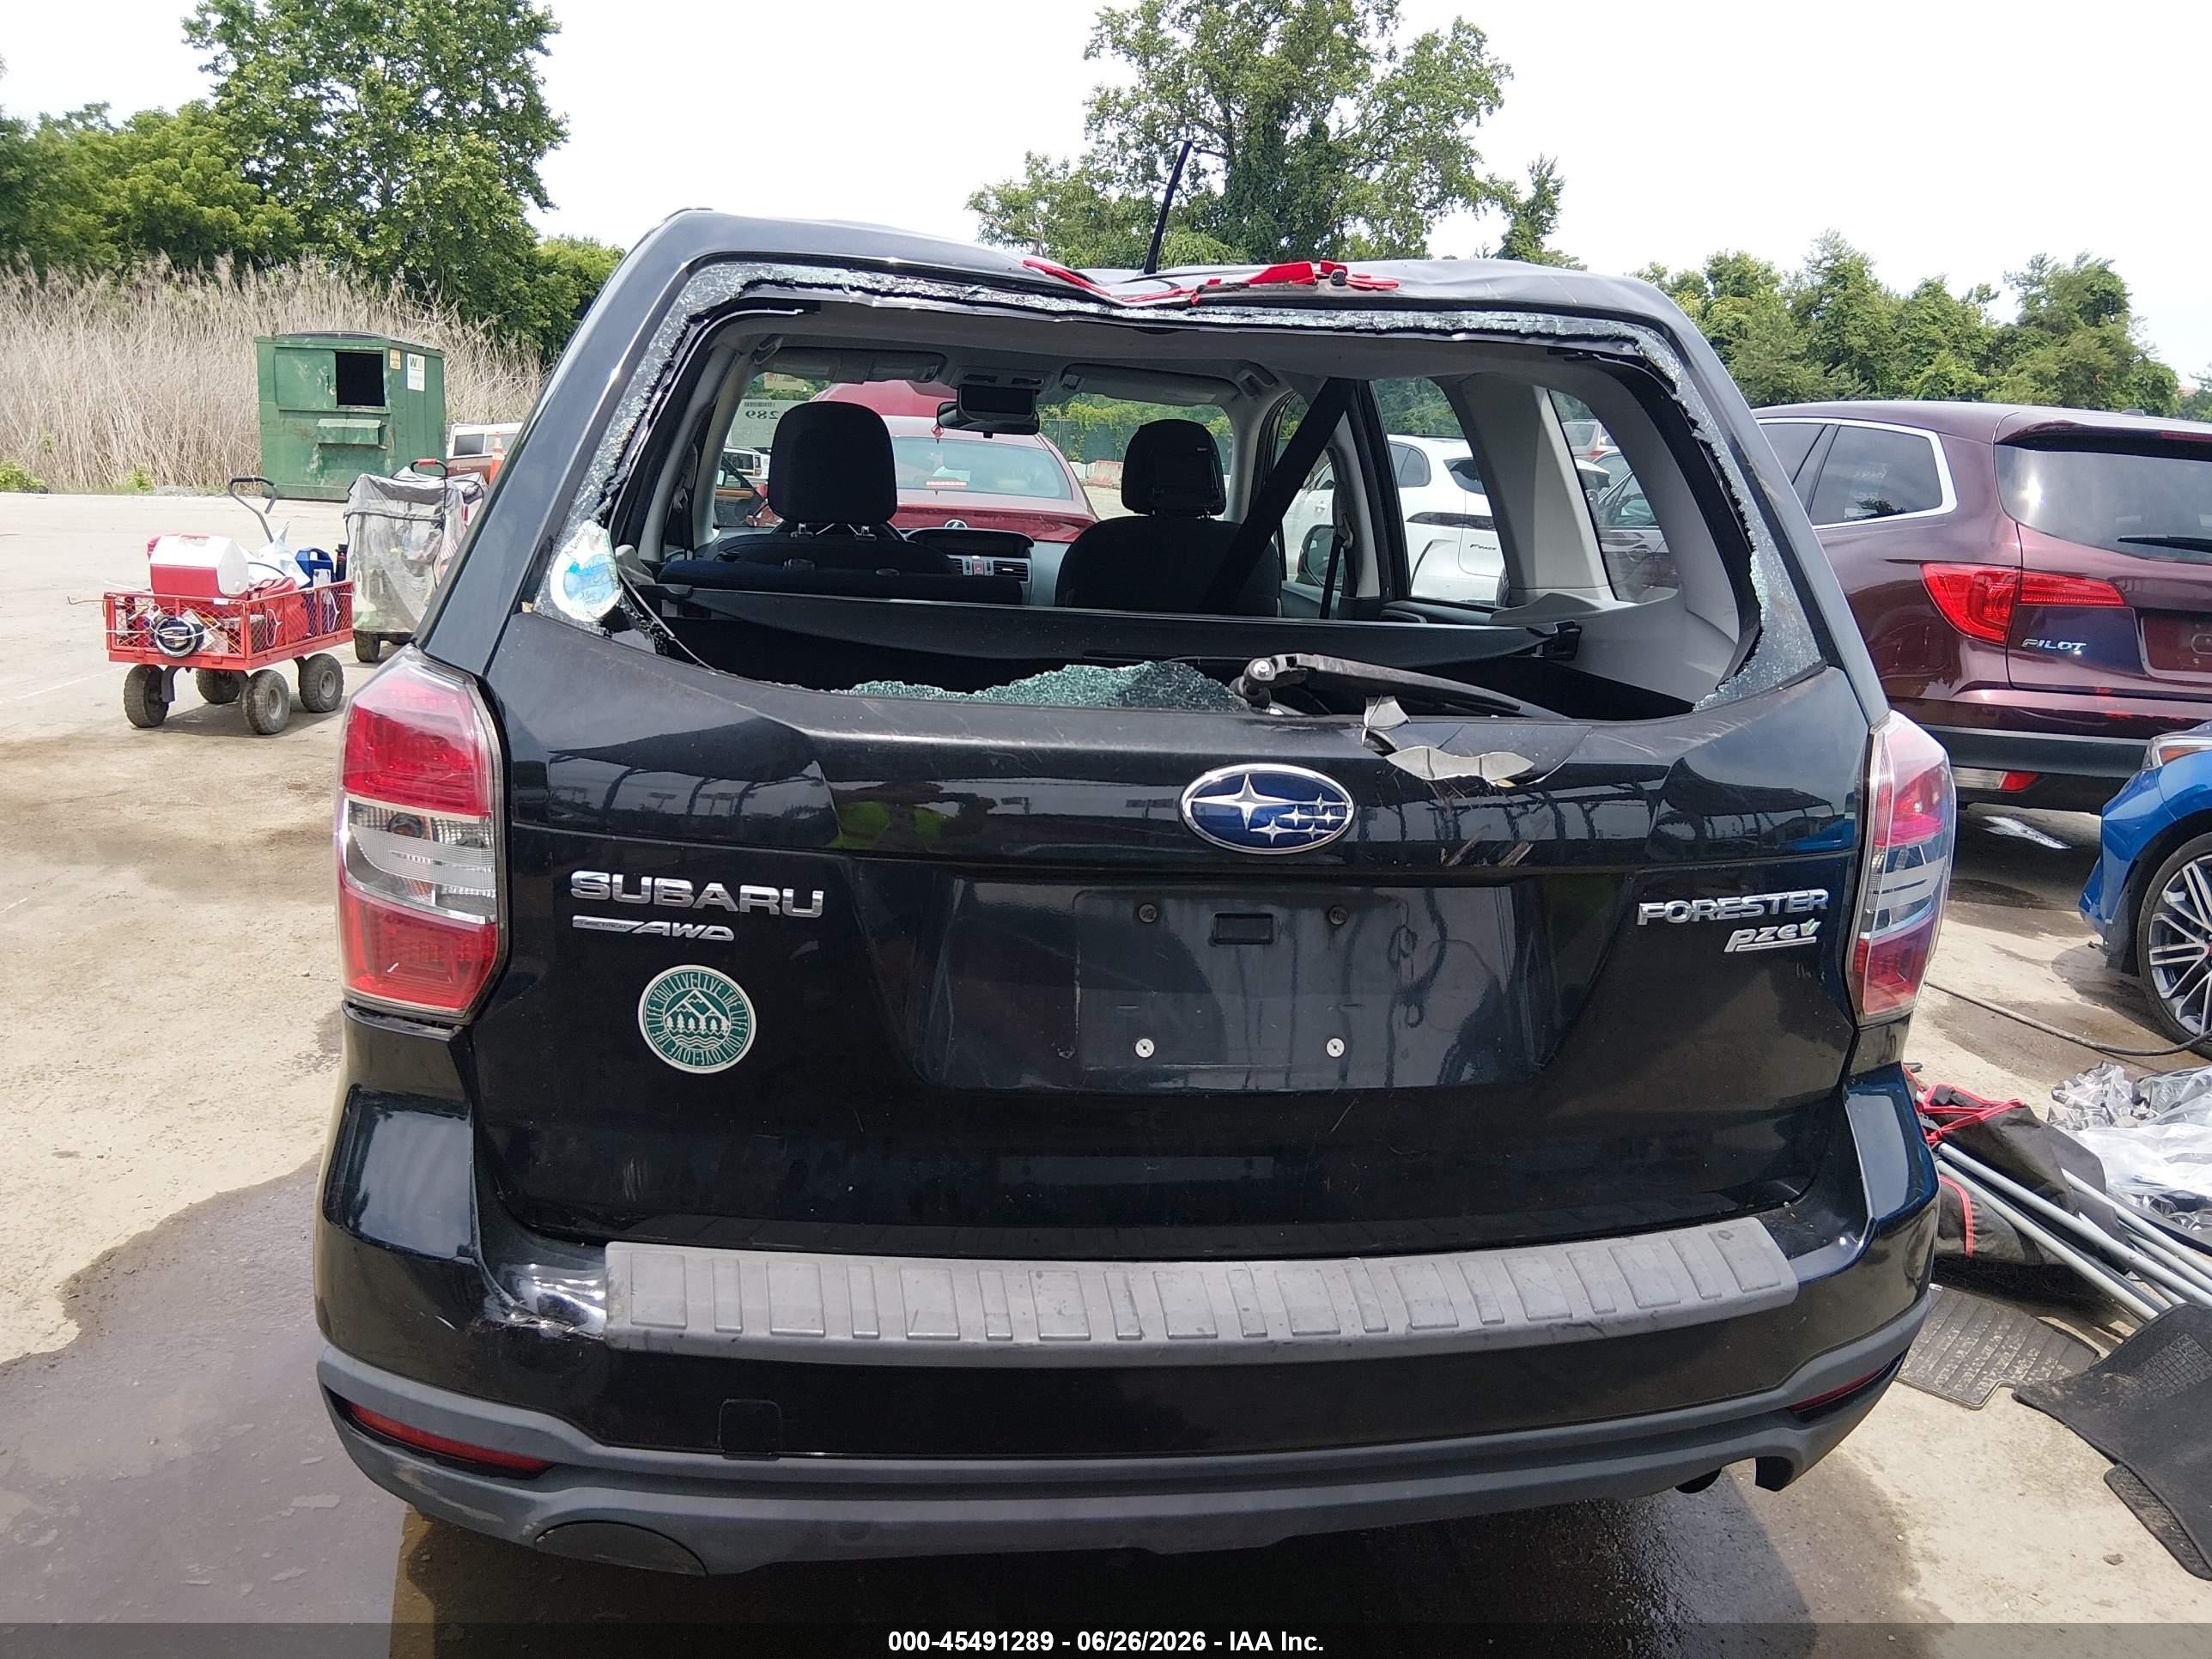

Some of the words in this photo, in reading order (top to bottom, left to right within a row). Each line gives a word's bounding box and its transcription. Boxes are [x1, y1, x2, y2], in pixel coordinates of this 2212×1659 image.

[2021, 638, 2087, 651] PILOT
[571, 870, 824, 919] SUBARU
[1637, 889, 1829, 926] FORESTER
[632, 921, 735, 942] AWD
[652, 983, 673, 1004] YOU
[723, 990, 742, 1009] THE
